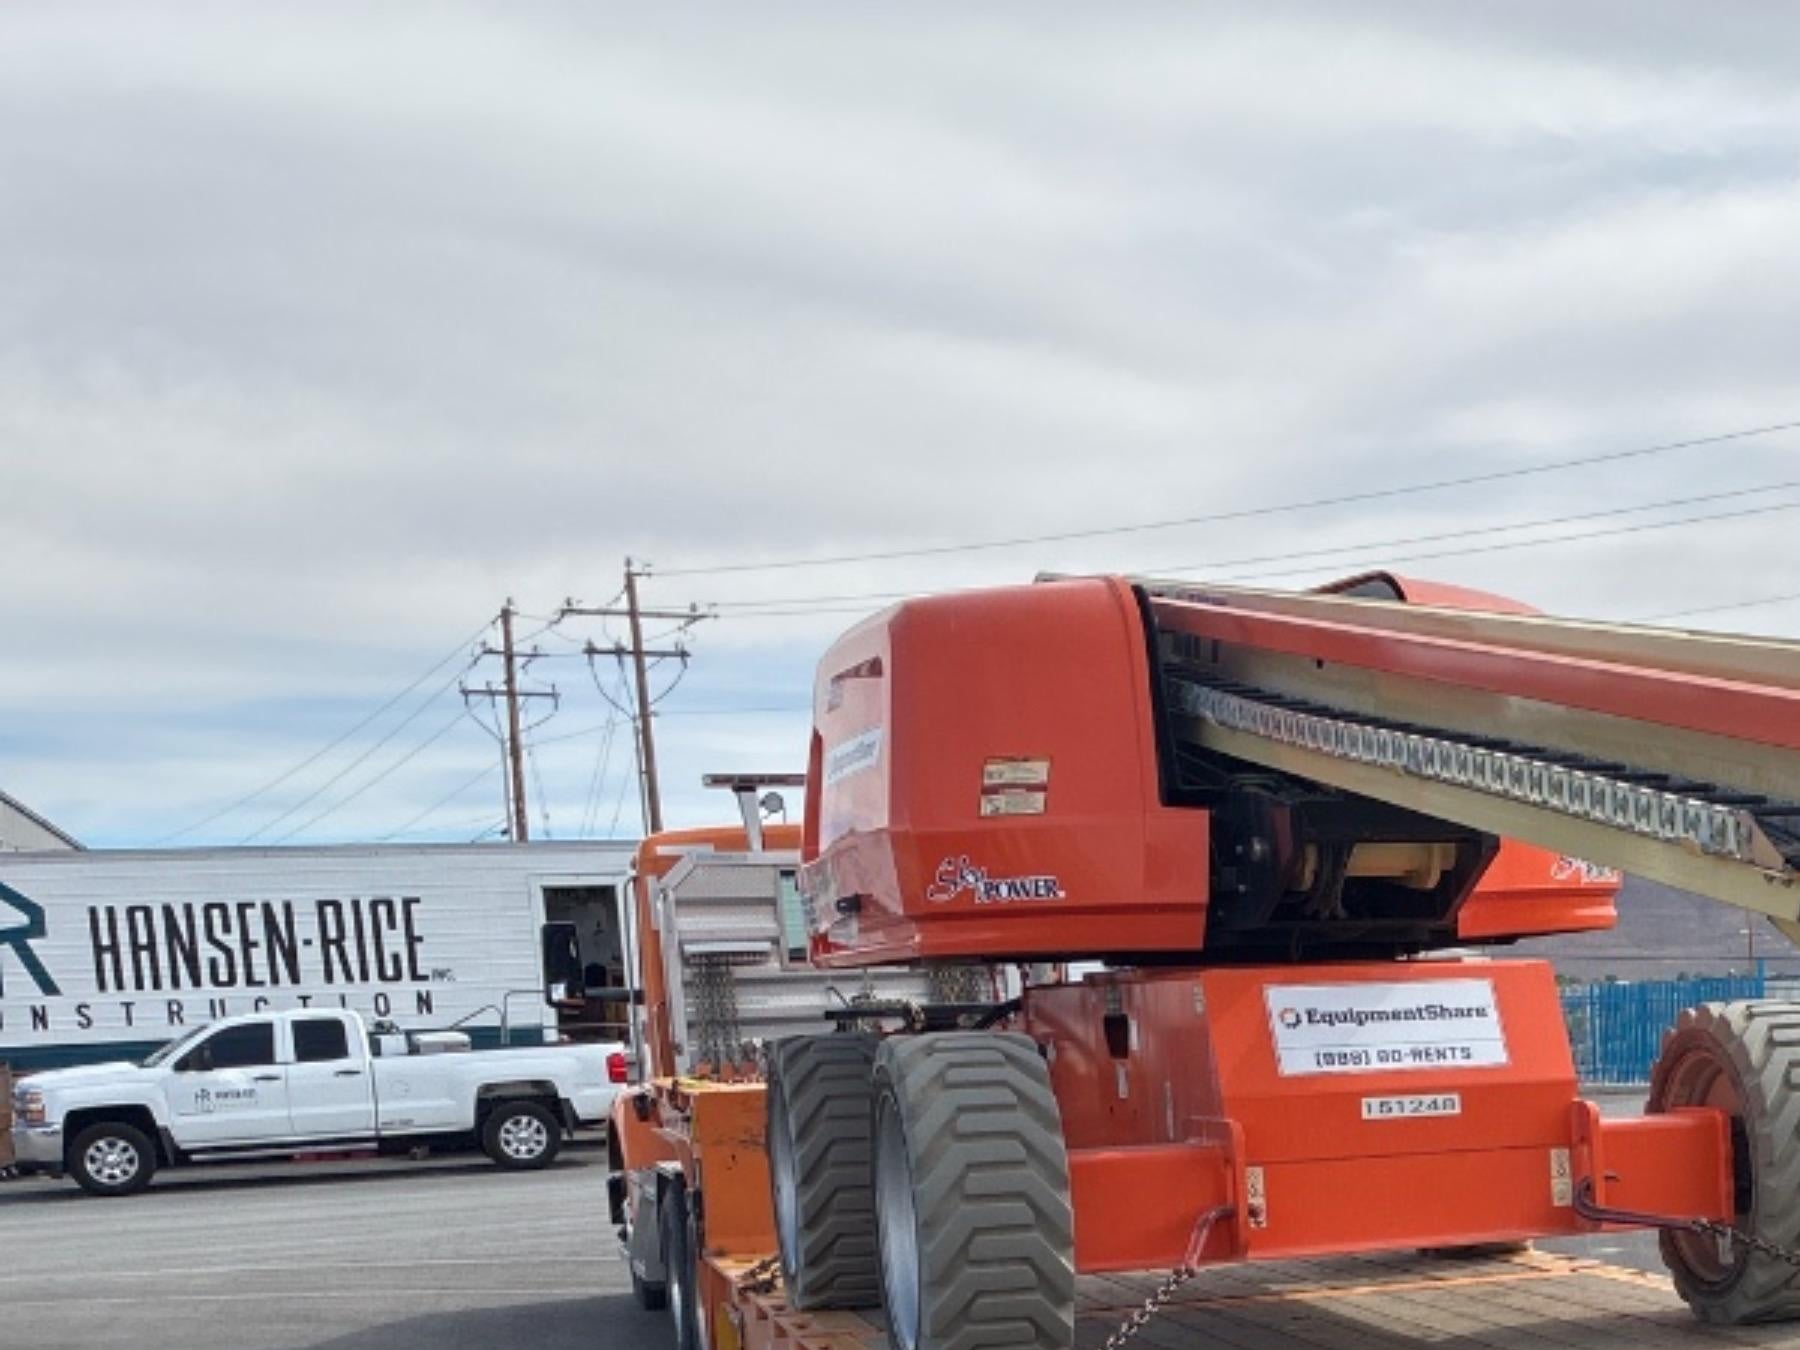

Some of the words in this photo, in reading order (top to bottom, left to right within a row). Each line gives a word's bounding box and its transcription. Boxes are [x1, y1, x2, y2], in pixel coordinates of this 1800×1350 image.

[88, 897, 430, 992] HANSEN-RICE
[0, 990, 433, 1031] NSTRUCTION
[1306, 1004, 1488, 1027] EquipmentShare
